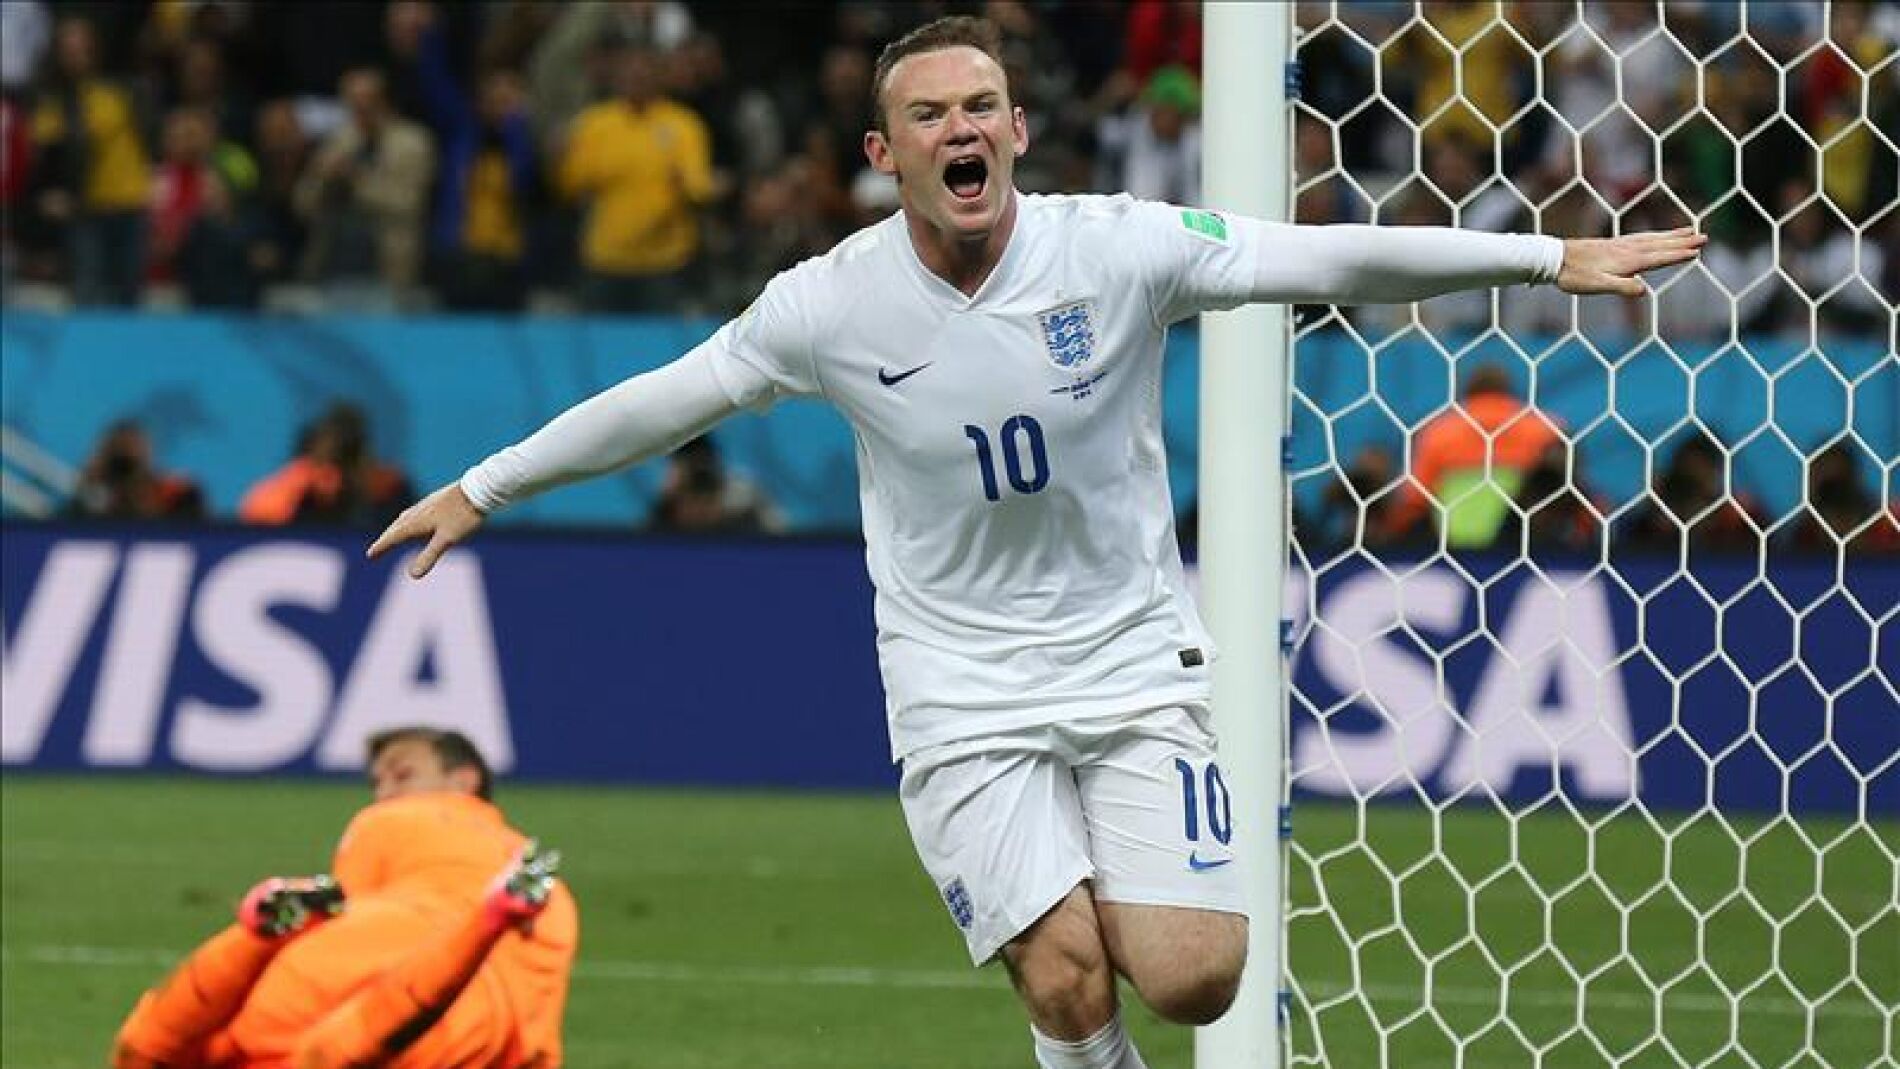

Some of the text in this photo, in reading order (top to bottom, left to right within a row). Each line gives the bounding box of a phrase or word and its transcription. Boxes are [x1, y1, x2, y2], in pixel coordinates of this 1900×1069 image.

[964, 415, 1050, 502] 10
[1184, 560, 1642, 797] SA
[1175, 757, 1231, 846] 10
